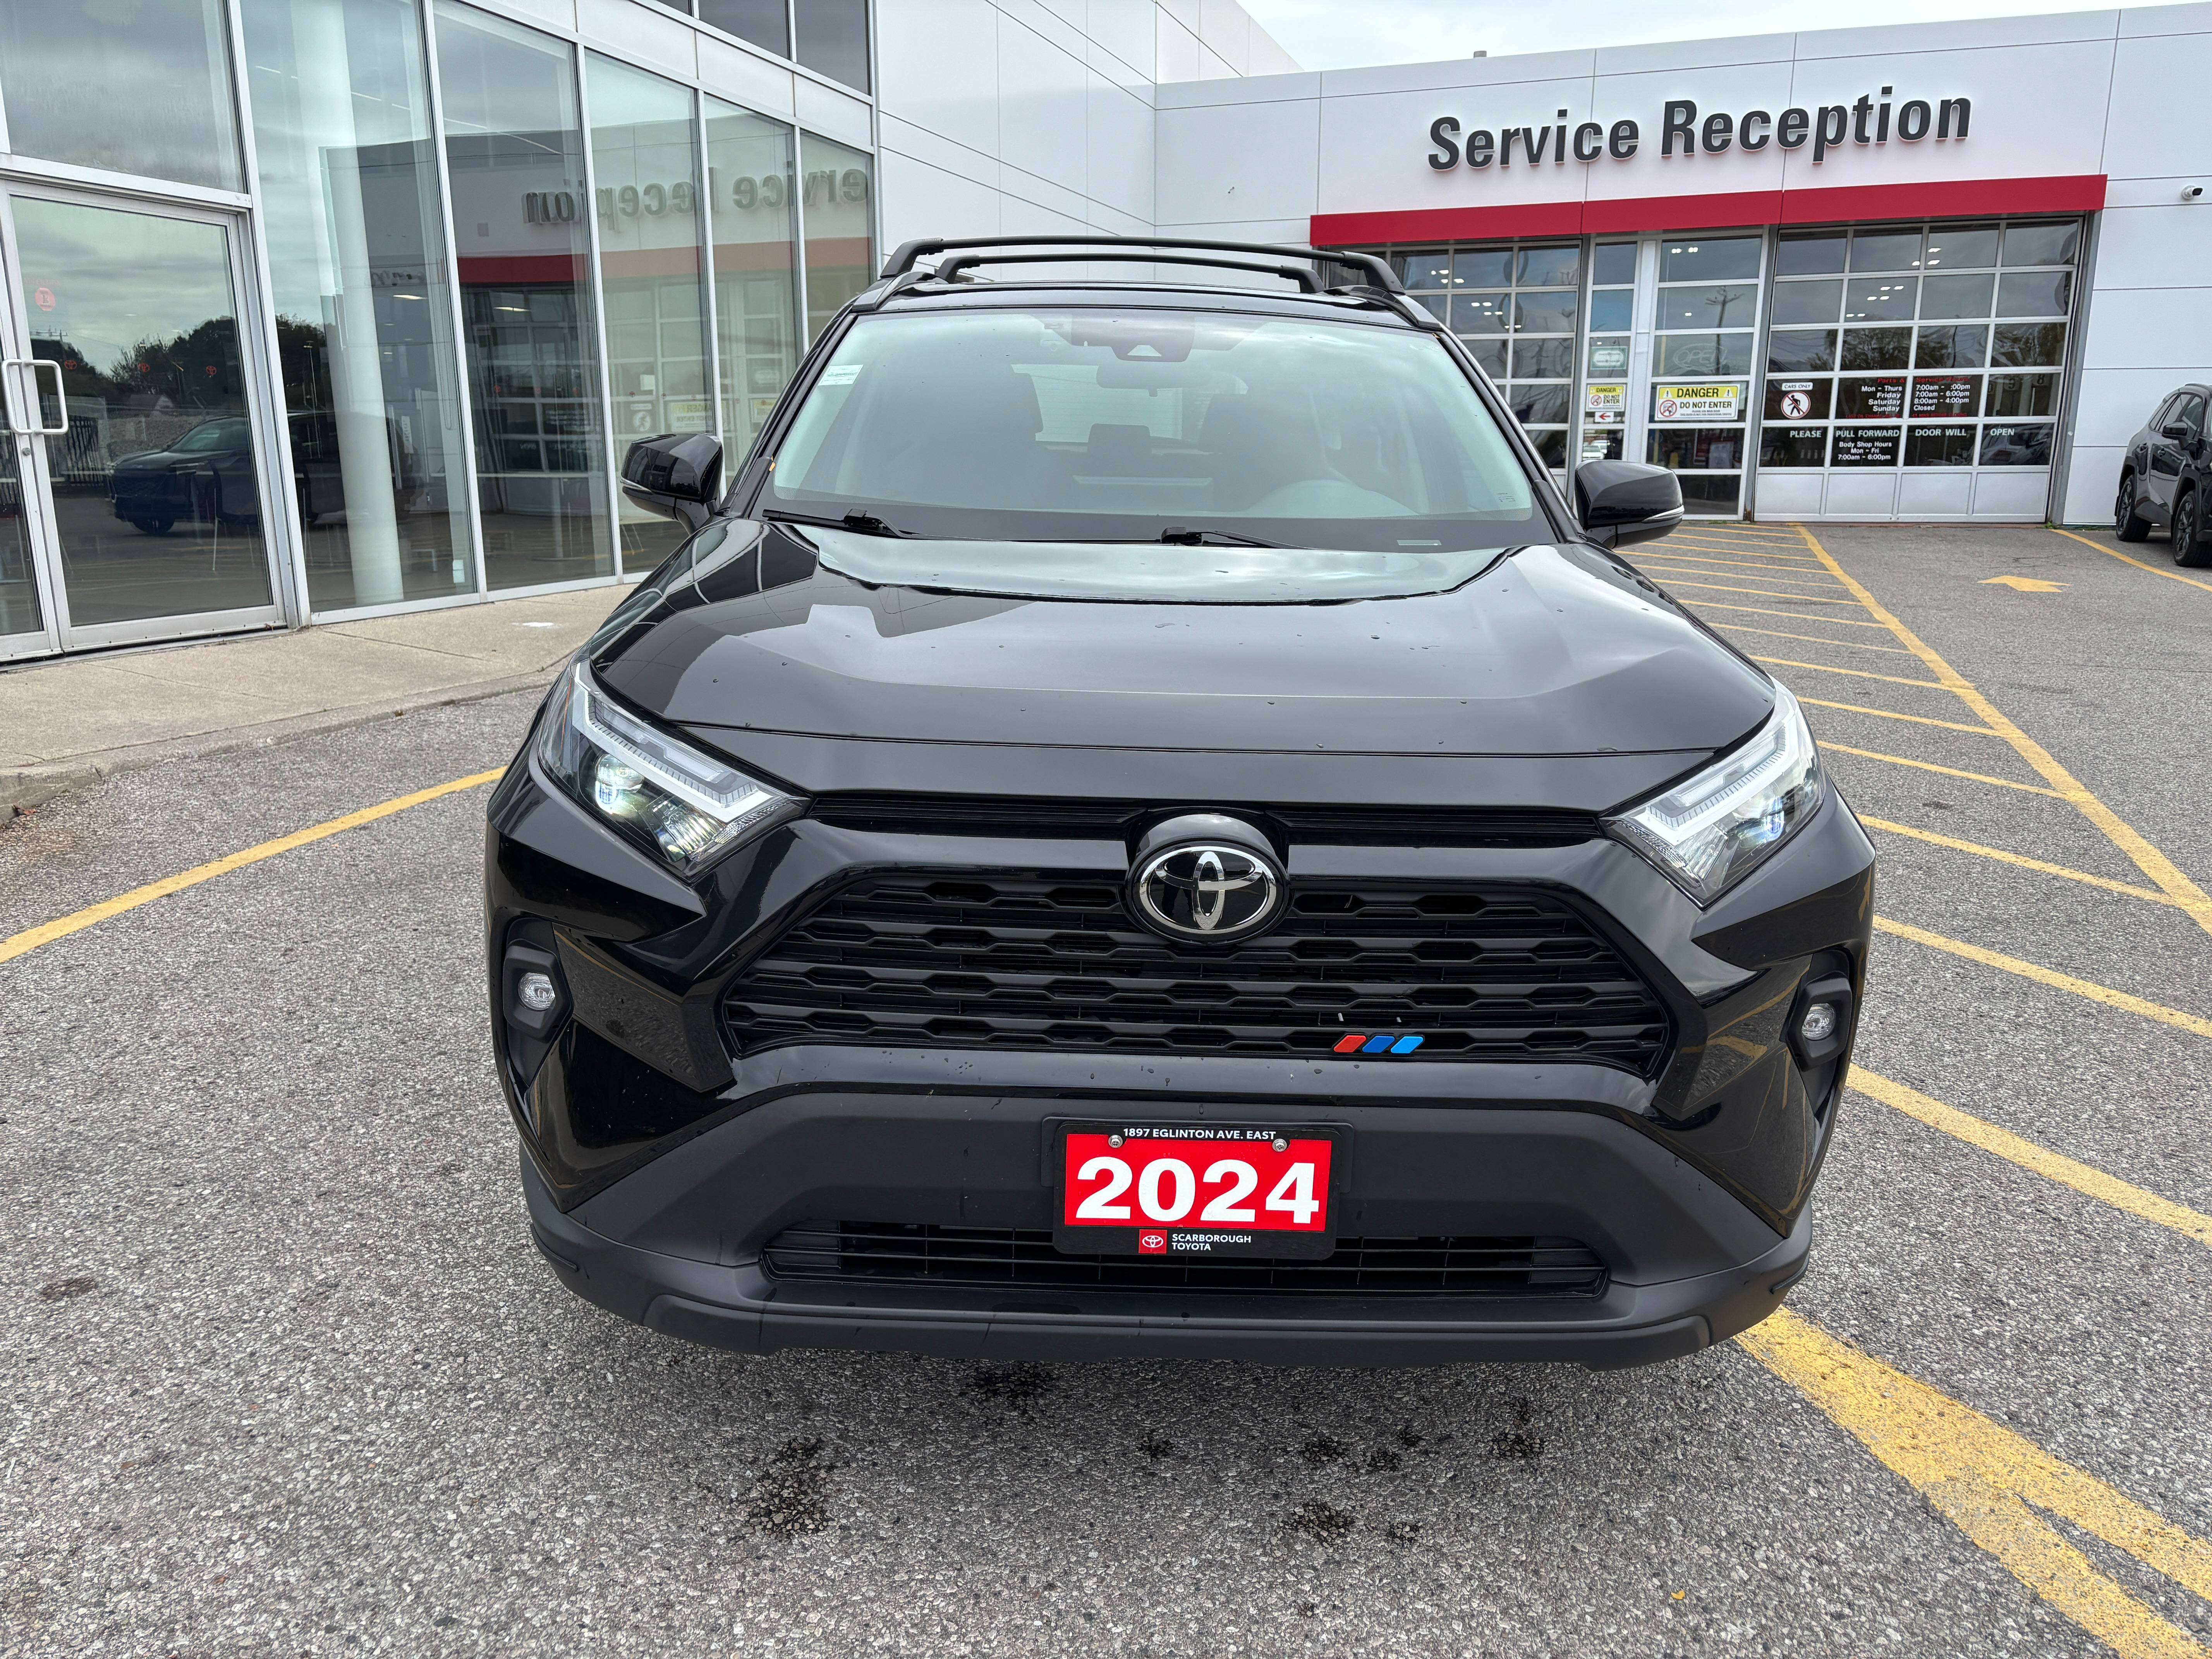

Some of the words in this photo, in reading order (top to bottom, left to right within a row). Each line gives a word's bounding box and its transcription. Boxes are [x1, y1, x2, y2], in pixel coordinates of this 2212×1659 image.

[1429, 109, 1639, 170] Service
[1661, 86, 1971, 163] Reception
[1676, 349, 1728, 364] OPEN
[1677, 388, 1719, 398] DANGER
[1123, 1128, 1149, 1137] 1897
[1153, 1129, 1214, 1139] EGLINTON
[1216, 1130, 1243, 1139] AVE.
[1247, 1130, 1276, 1140] EAST
[1075, 1156, 1319, 1224] 2024
[1172, 1233, 1251, 1243] SCARBOROUGH
[1171, 1242, 1211, 1251] TOYOTA
